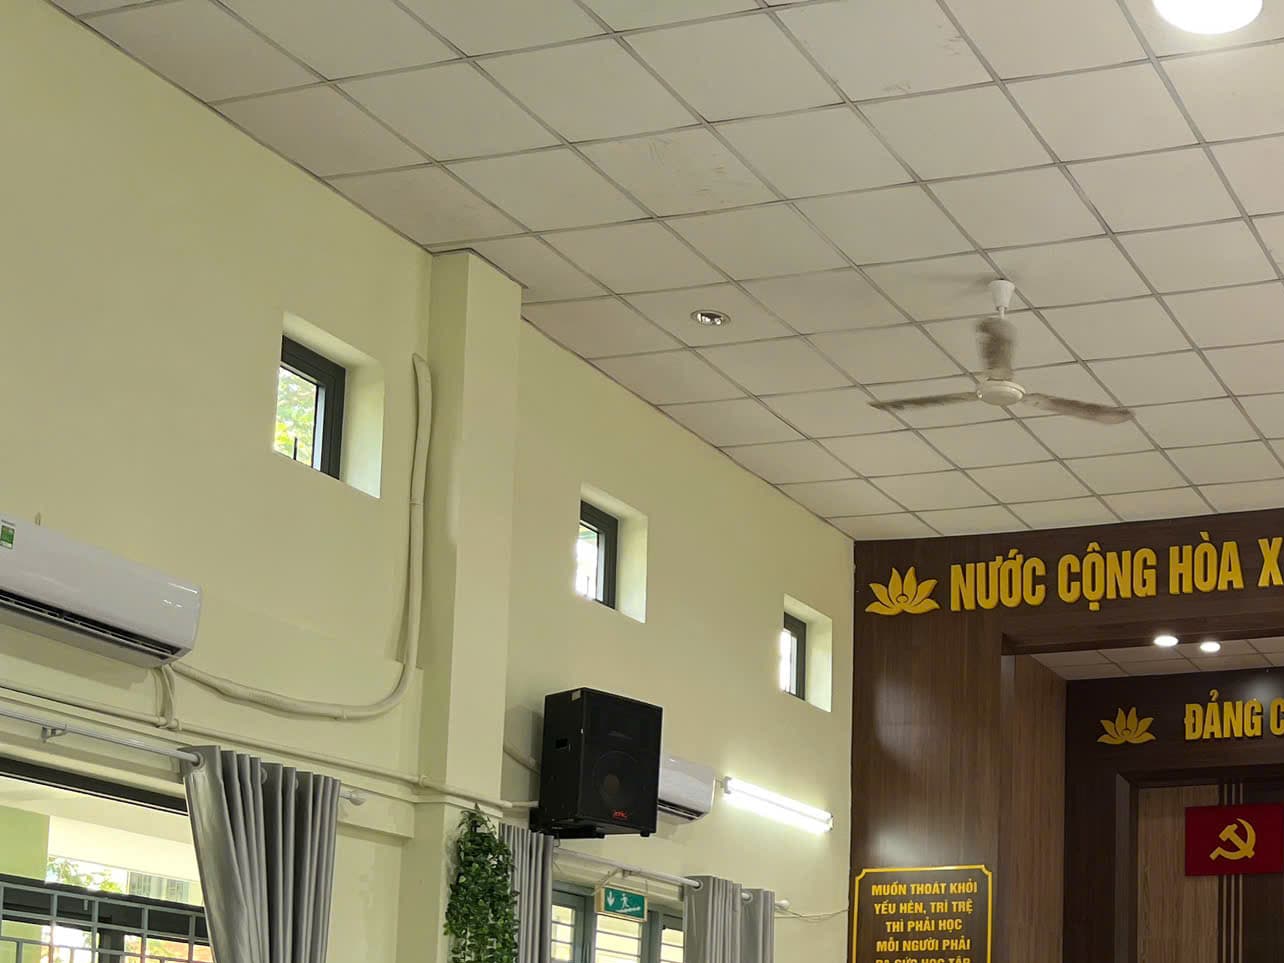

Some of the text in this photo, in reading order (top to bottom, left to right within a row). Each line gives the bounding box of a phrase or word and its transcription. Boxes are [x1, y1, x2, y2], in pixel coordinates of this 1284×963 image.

[950, 554, 1047, 612] NƯỚC
[1058, 541, 1157, 611] CỘNG
[1169, 531, 1244, 596] HÒA
[1184, 688, 1263, 742] ĐẢNG
[939, 918, 962, 933] HỌC
